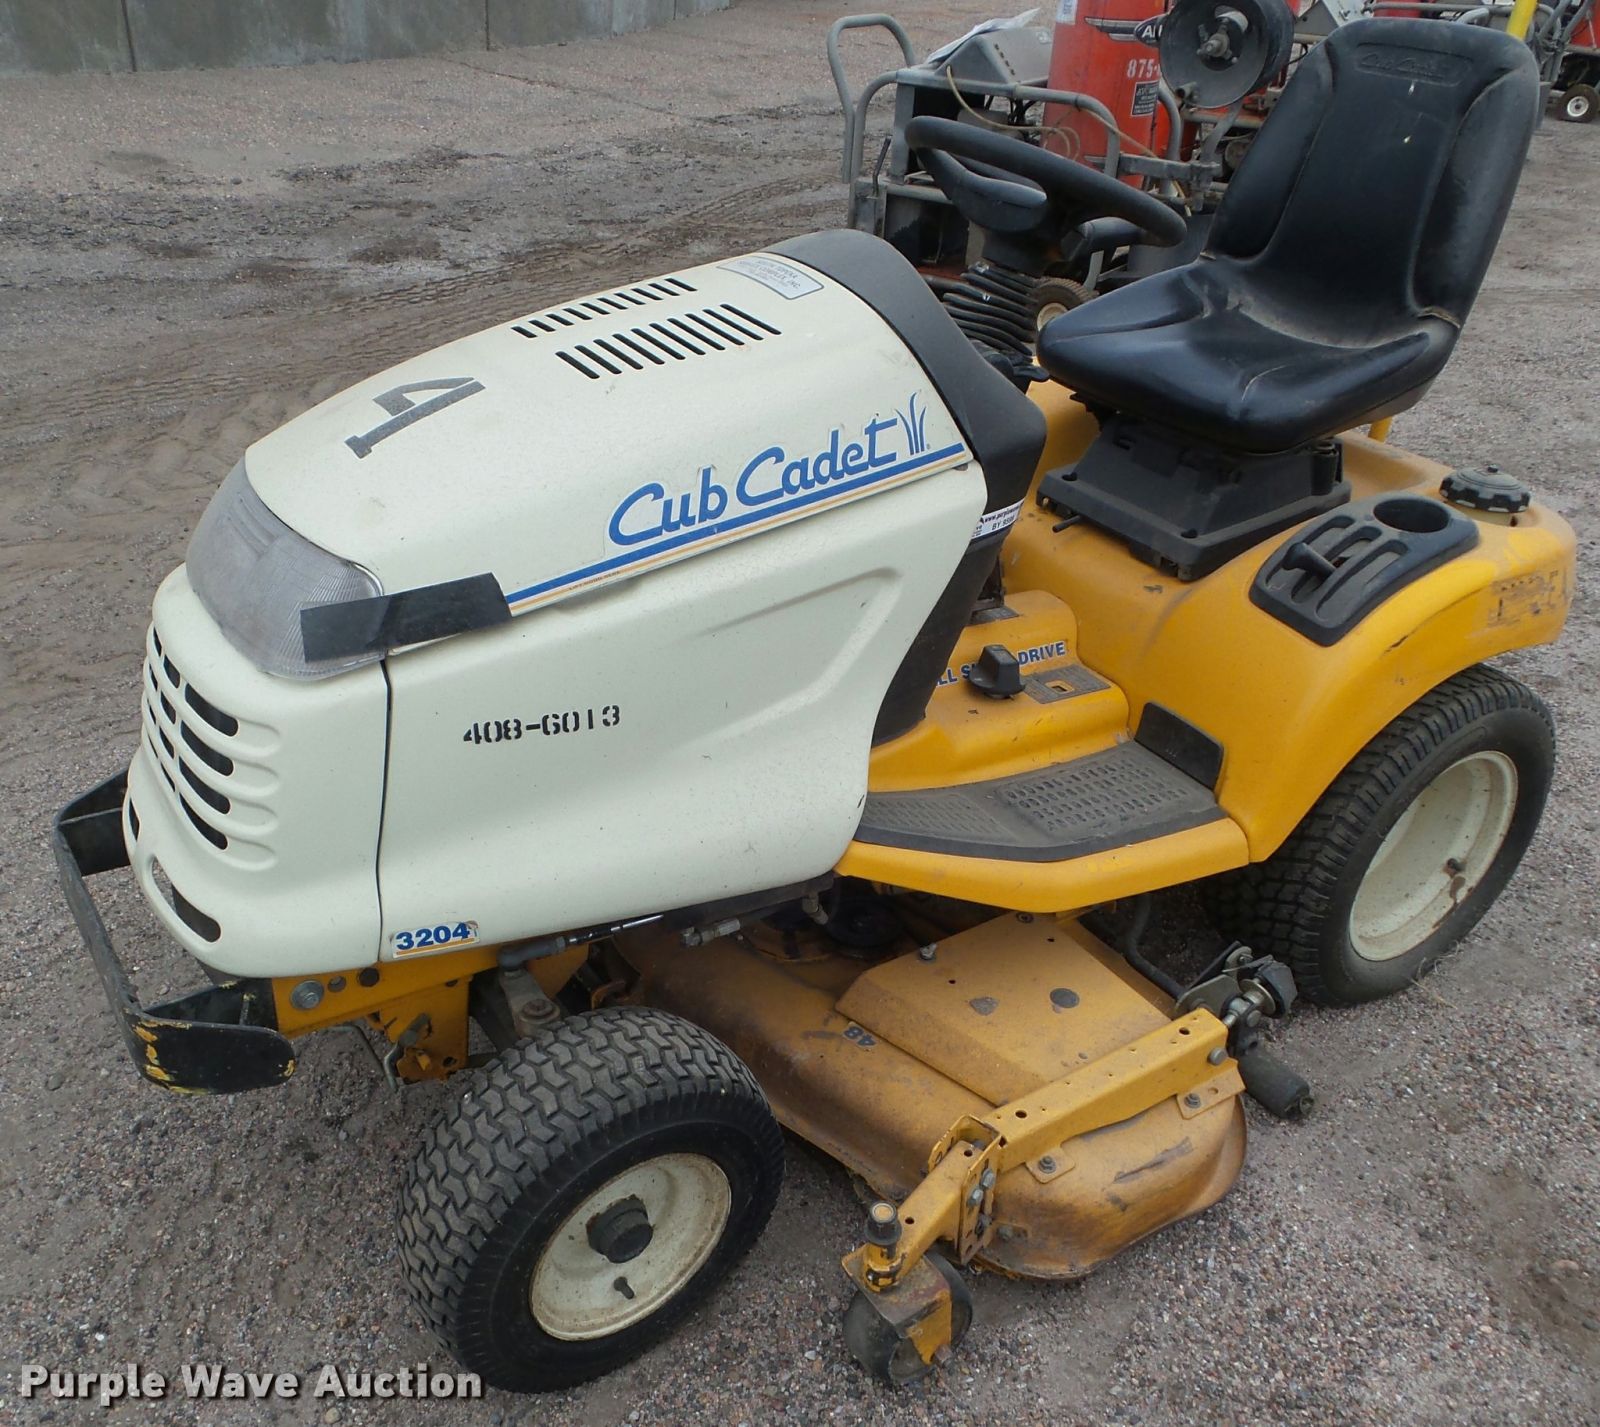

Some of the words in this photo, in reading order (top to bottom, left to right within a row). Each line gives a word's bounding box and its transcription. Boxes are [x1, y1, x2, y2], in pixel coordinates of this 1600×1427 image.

[344, 377, 486, 459] 4
[608, 467, 728, 546] Cub
[736, 416, 898, 507] Cadet
[1018, 641, 1066, 666] DRIVE
[463, 704, 620, 745] 408-6013
[396, 921, 471, 950] 3204
